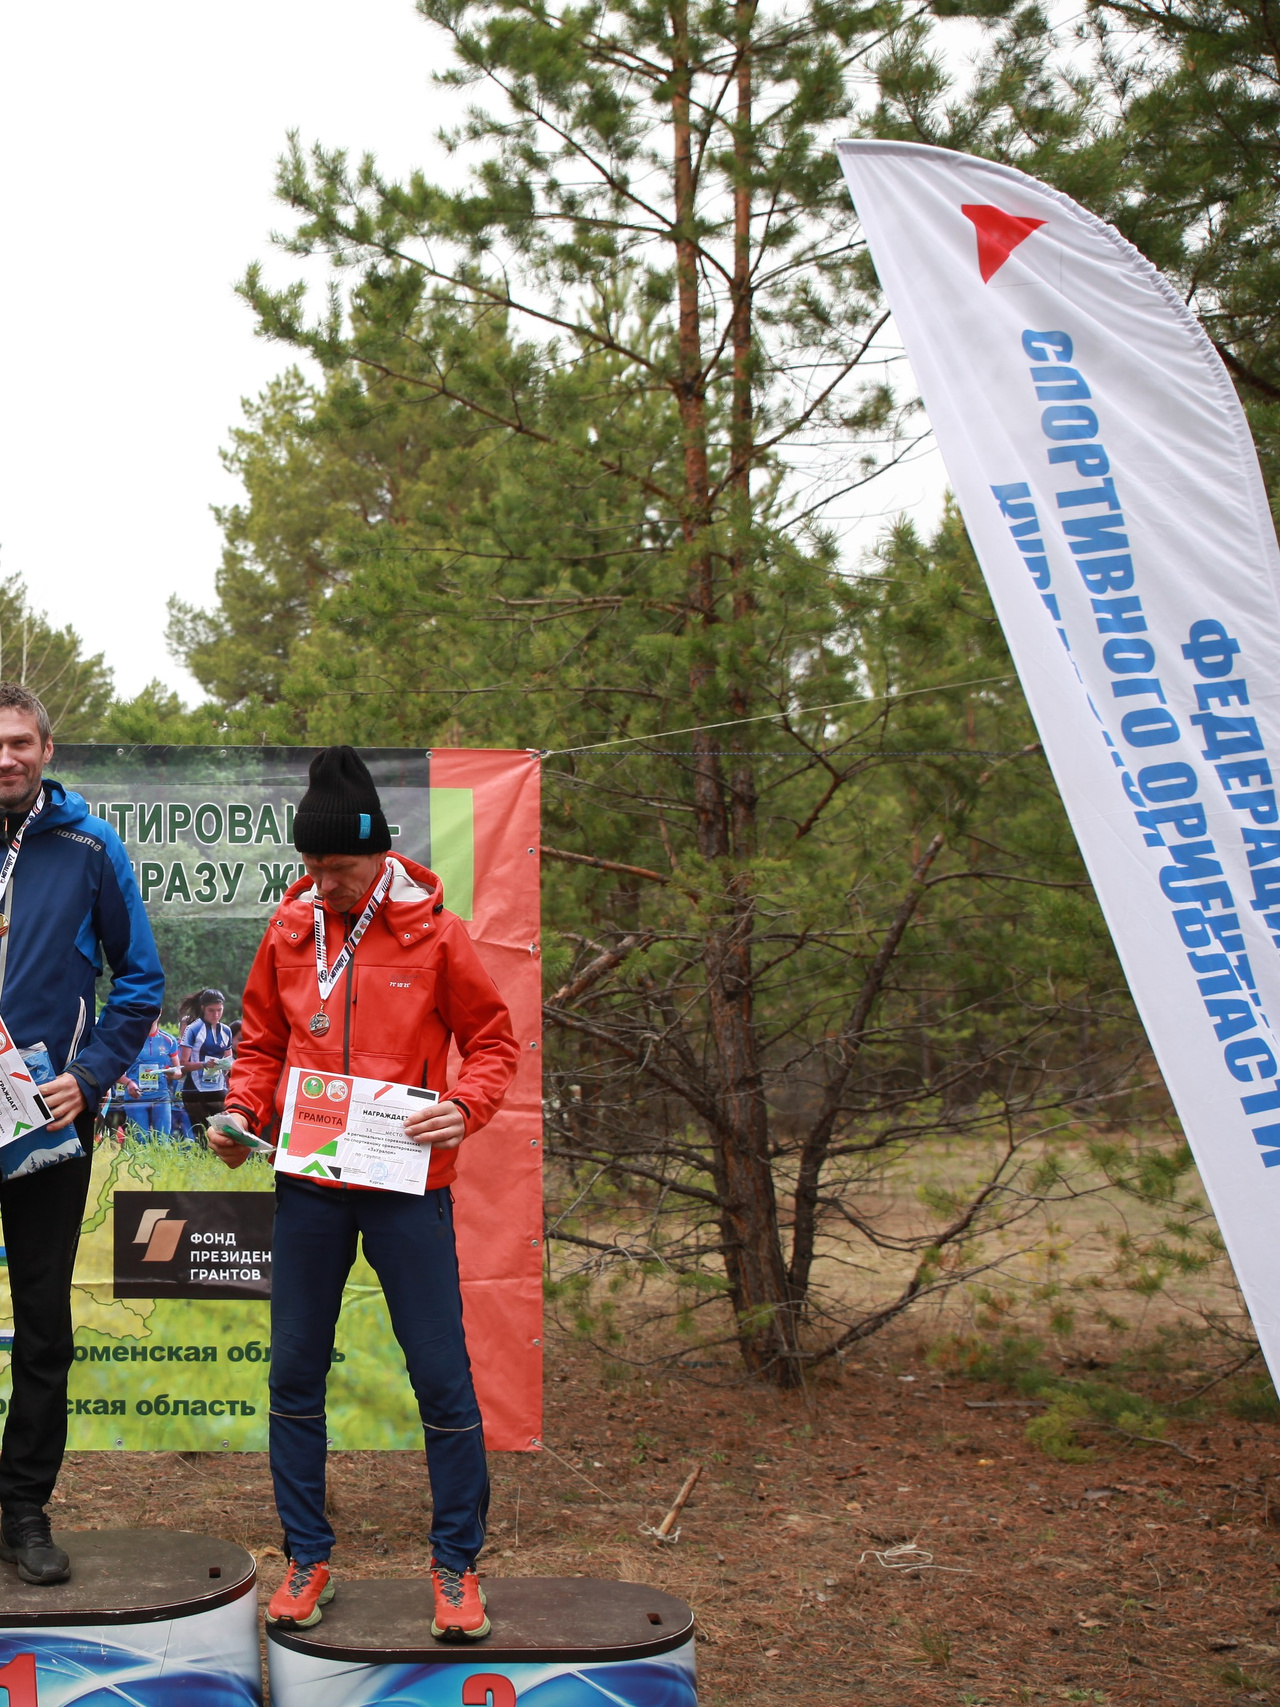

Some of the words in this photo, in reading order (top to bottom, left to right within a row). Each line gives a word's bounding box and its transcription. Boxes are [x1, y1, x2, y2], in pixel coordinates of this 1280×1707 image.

[1021, 329, 1181, 748] СПОРТИВНОГО
[52, 828, 102, 852] noname
[132, 862, 244, 903] РАЗУ
[298, 1111, 343, 1127] ГРАМОТА
[190, 1233, 236, 1246] ФОНД
[190, 1250, 272, 1264] ПРЕЗИДЕН
[190, 1269, 261, 1280] ГРАНТОВ
[136, 1394, 255, 1416] область
